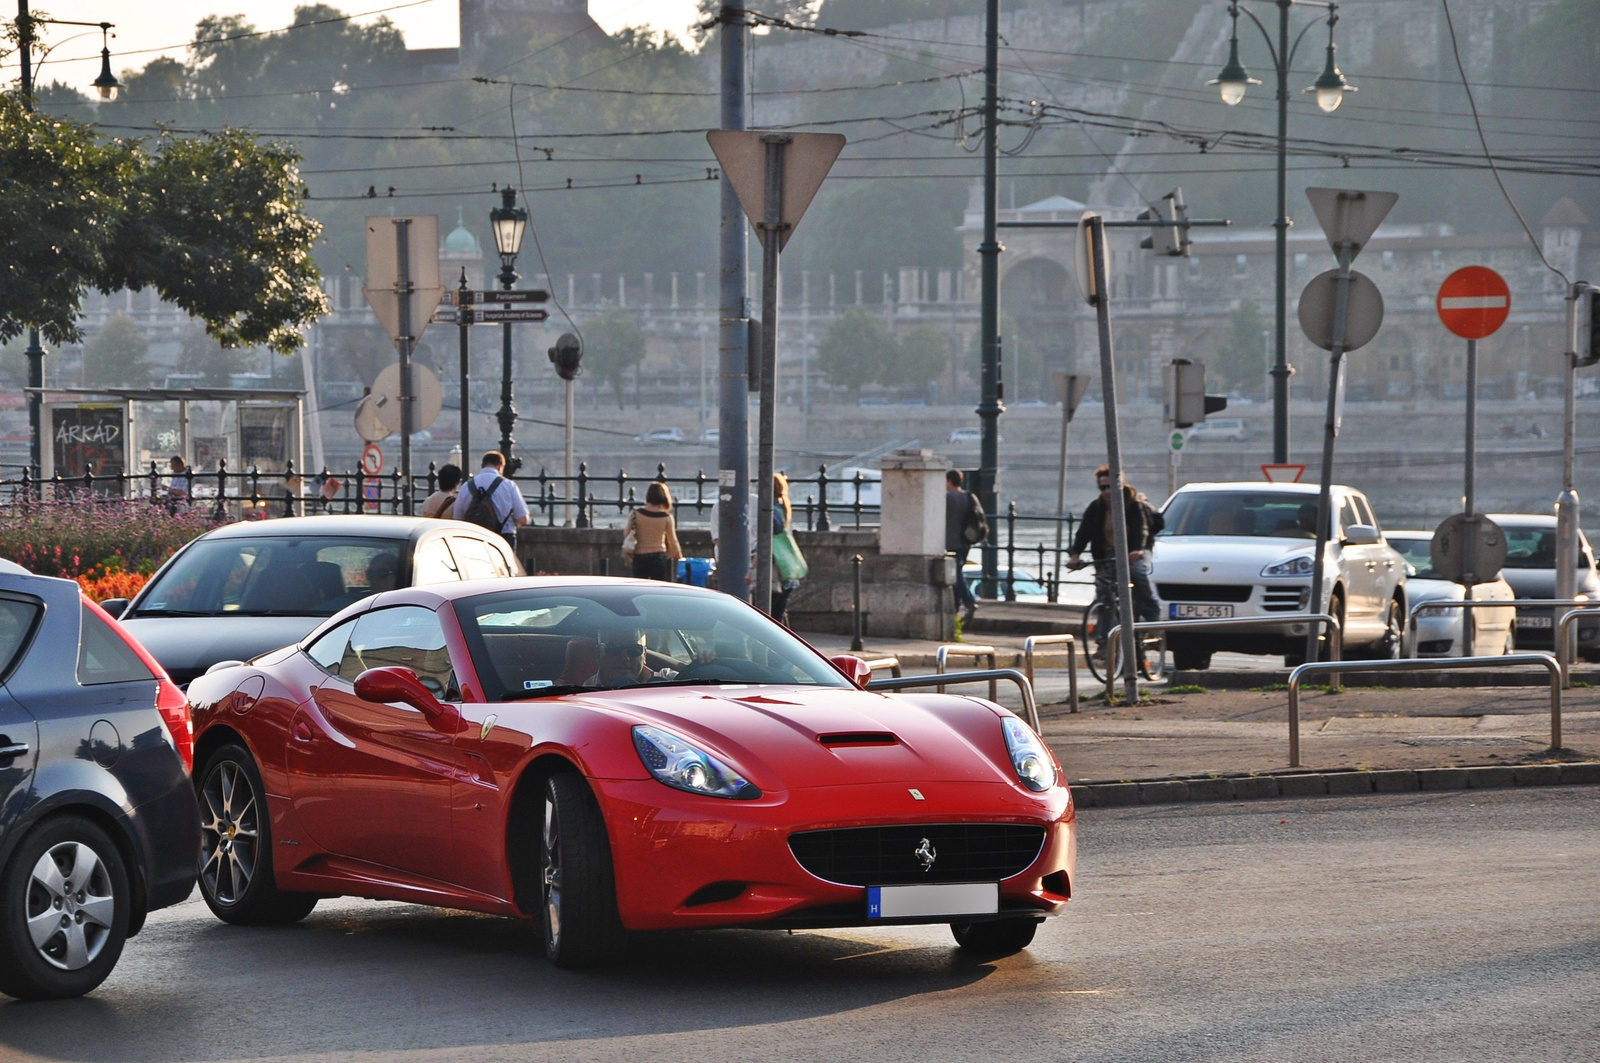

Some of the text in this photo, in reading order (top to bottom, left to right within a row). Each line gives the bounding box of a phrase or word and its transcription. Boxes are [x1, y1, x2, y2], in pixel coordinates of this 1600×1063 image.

[56, 419, 119, 443] ÁRKÁD
[1178, 606, 1229, 617] LPL-051
[870, 904, 878, 913] H
